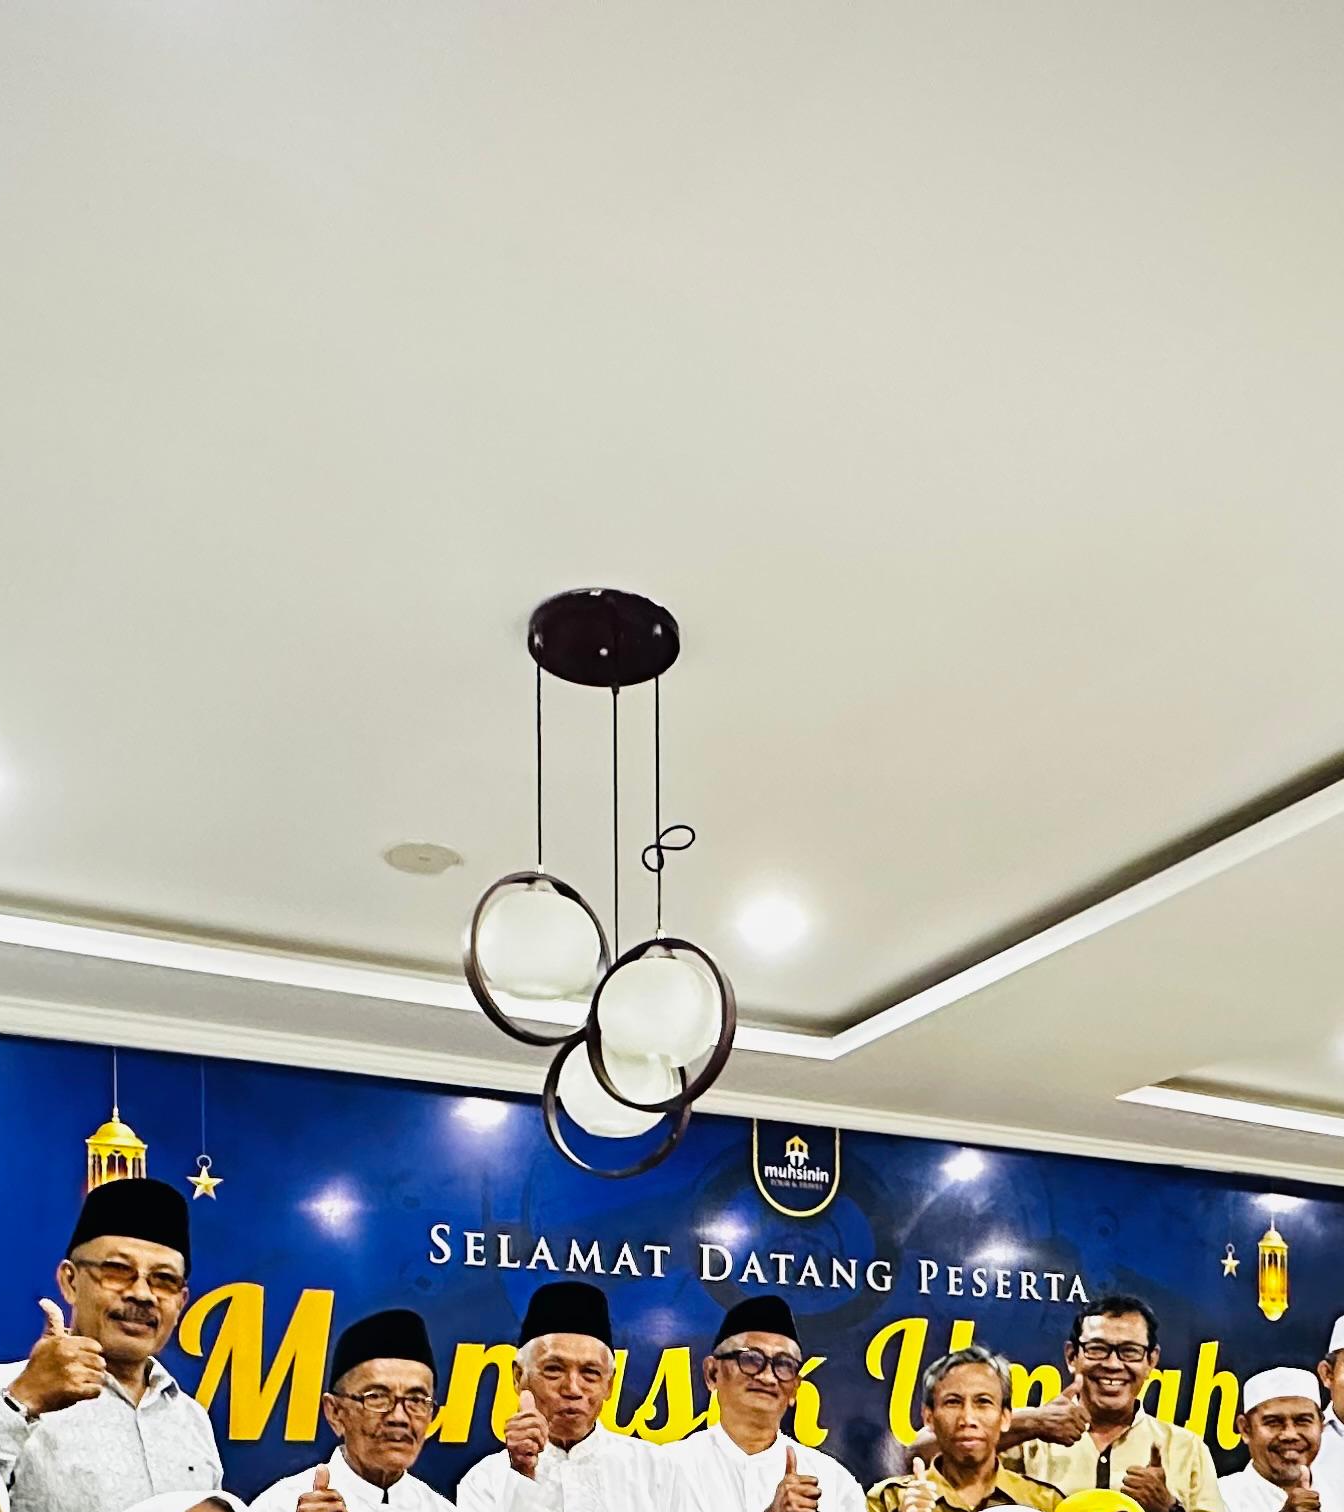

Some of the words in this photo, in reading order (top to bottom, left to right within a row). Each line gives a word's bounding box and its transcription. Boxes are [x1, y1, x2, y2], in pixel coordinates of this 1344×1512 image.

[764, 1163, 830, 1184] muhsinin
[429, 1223, 671, 1278] SELAMAT
[699, 1243, 893, 1292] DATANG
[918, 1258, 1090, 1303] PESERTA
